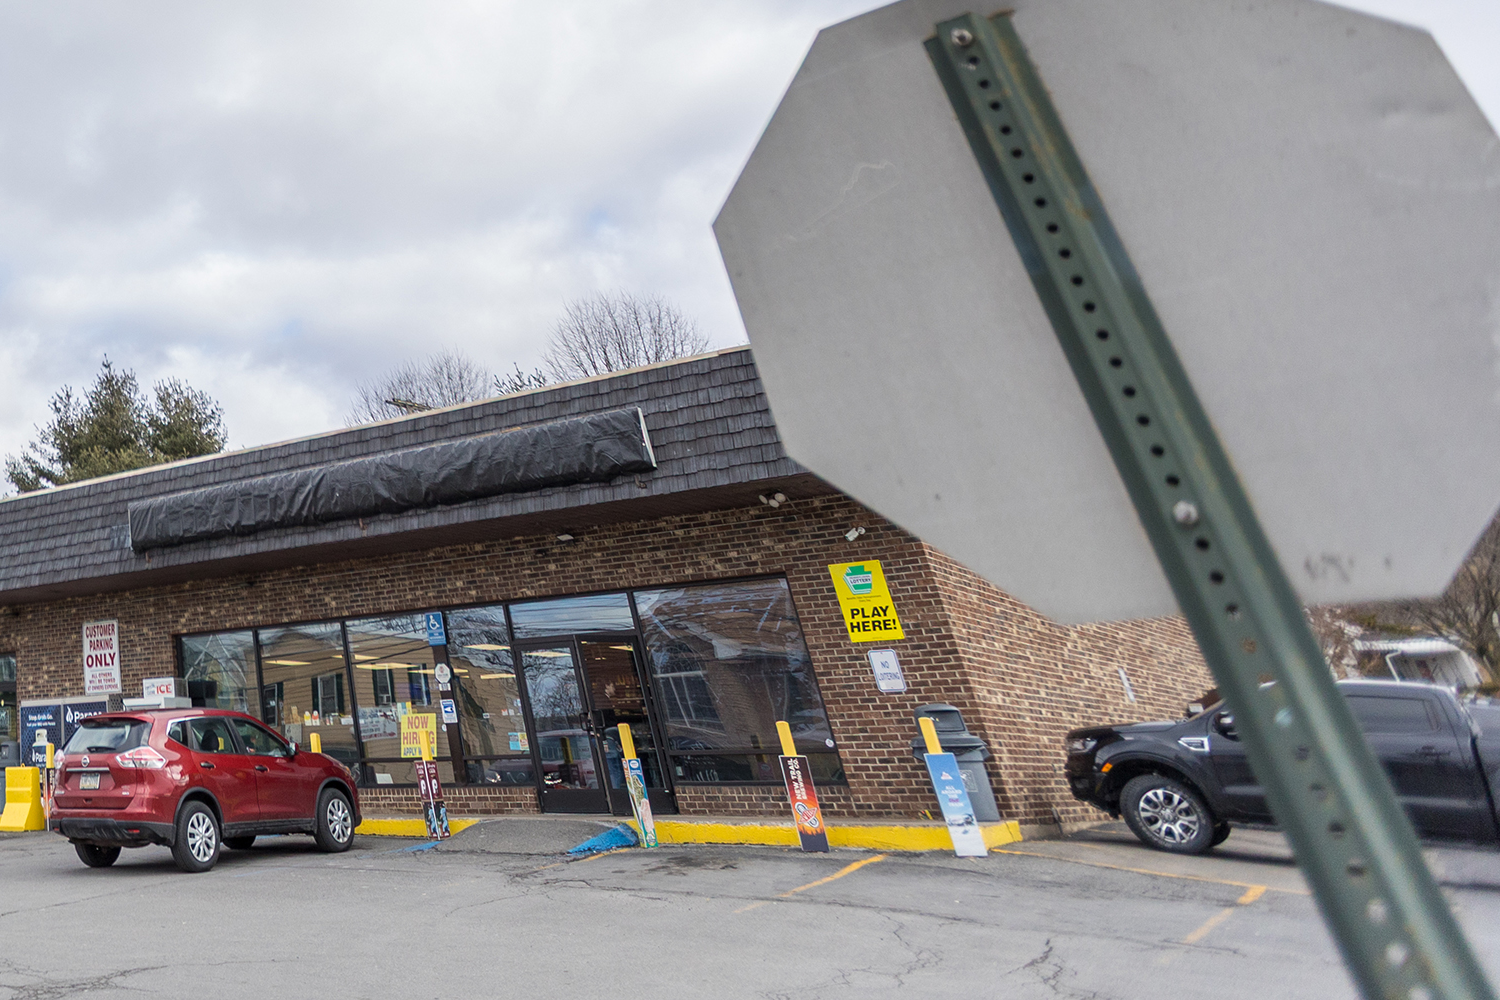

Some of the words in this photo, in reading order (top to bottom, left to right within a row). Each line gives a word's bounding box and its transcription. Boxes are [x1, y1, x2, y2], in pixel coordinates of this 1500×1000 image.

[850, 606, 889, 619] PLAY
[85, 623, 116, 639] CUSTOMER
[850, 619, 897, 633] HERE!
[89, 638, 113, 652] PARKING
[86, 652, 116, 668] ONLY
[880, 660, 890, 669] NO
[877, 672, 900, 681] LOITERING
[156, 684, 172, 694] ICE
[407, 716, 429, 729] NOW
[403, 747, 417, 757] APPLY
[787, 758, 797, 780] TRAIL
[792, 781, 802, 800] NEW
